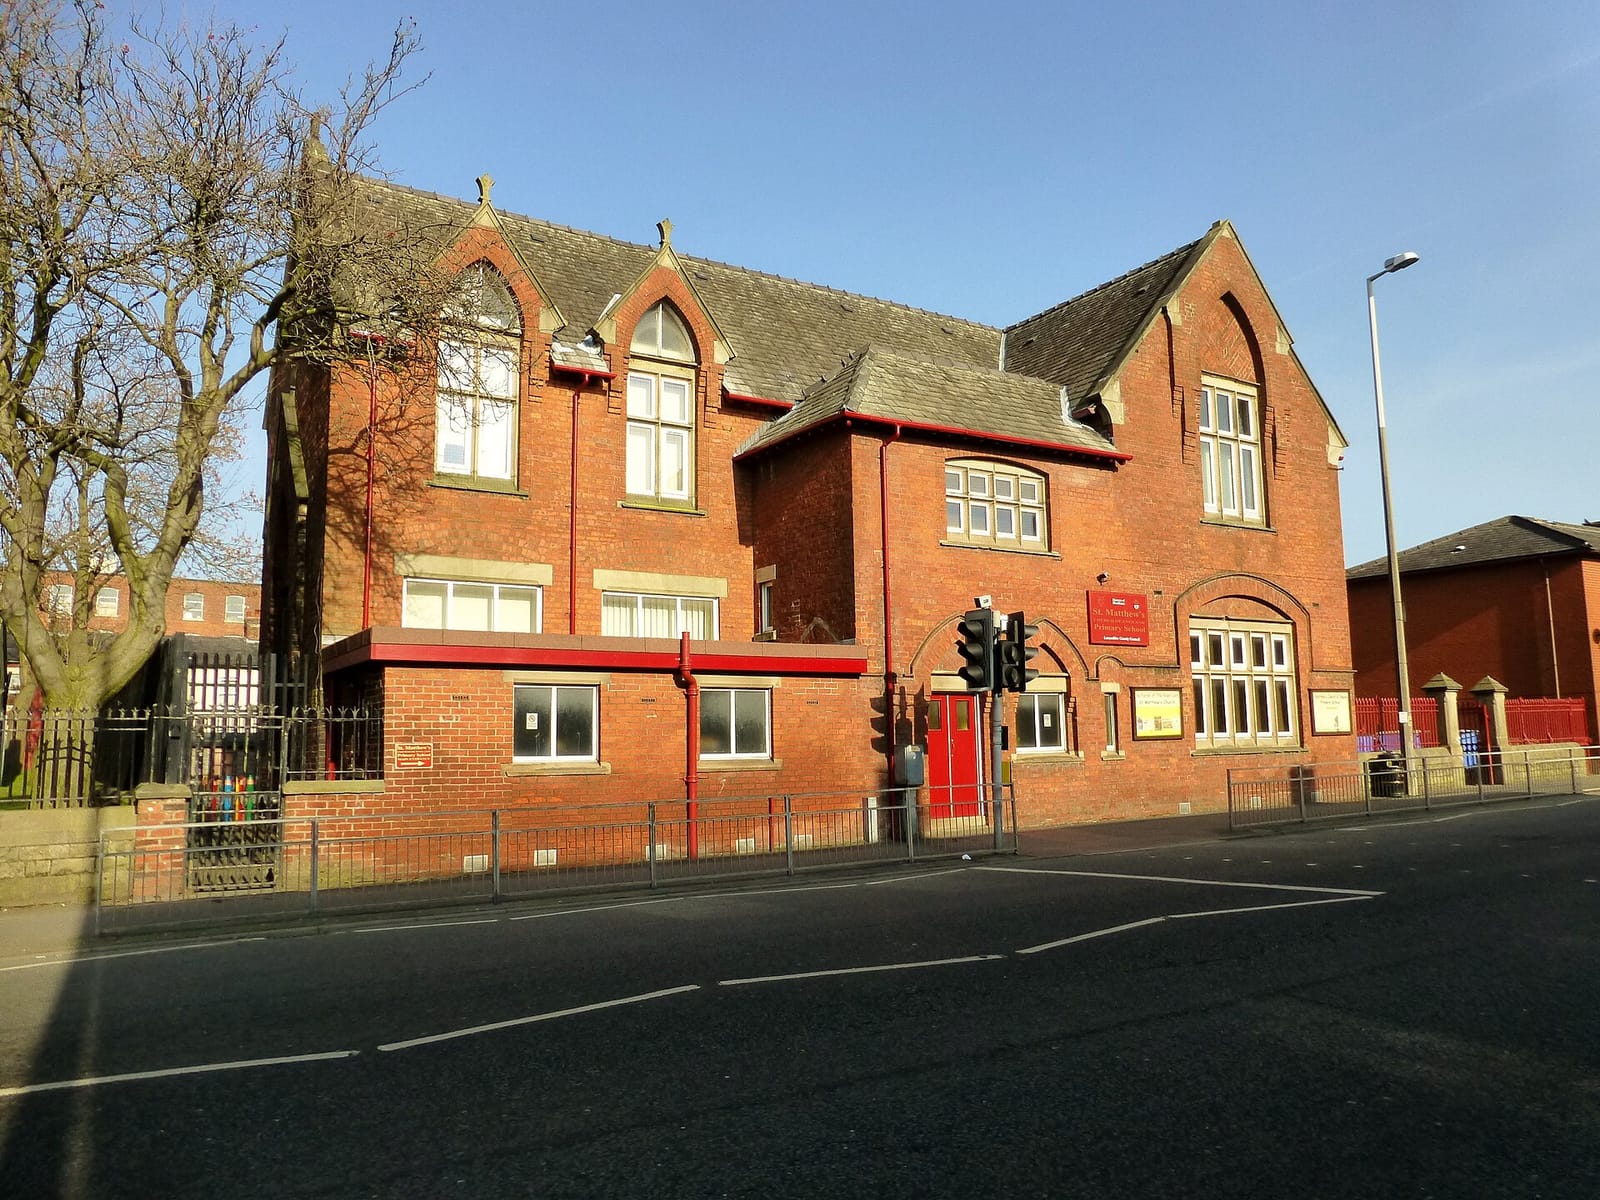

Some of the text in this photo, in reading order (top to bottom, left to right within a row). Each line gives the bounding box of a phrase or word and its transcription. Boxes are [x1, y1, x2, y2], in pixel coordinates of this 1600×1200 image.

[1092, 607, 1145, 618] St. Matthew's
[1094, 623, 1146, 633] Primary School
